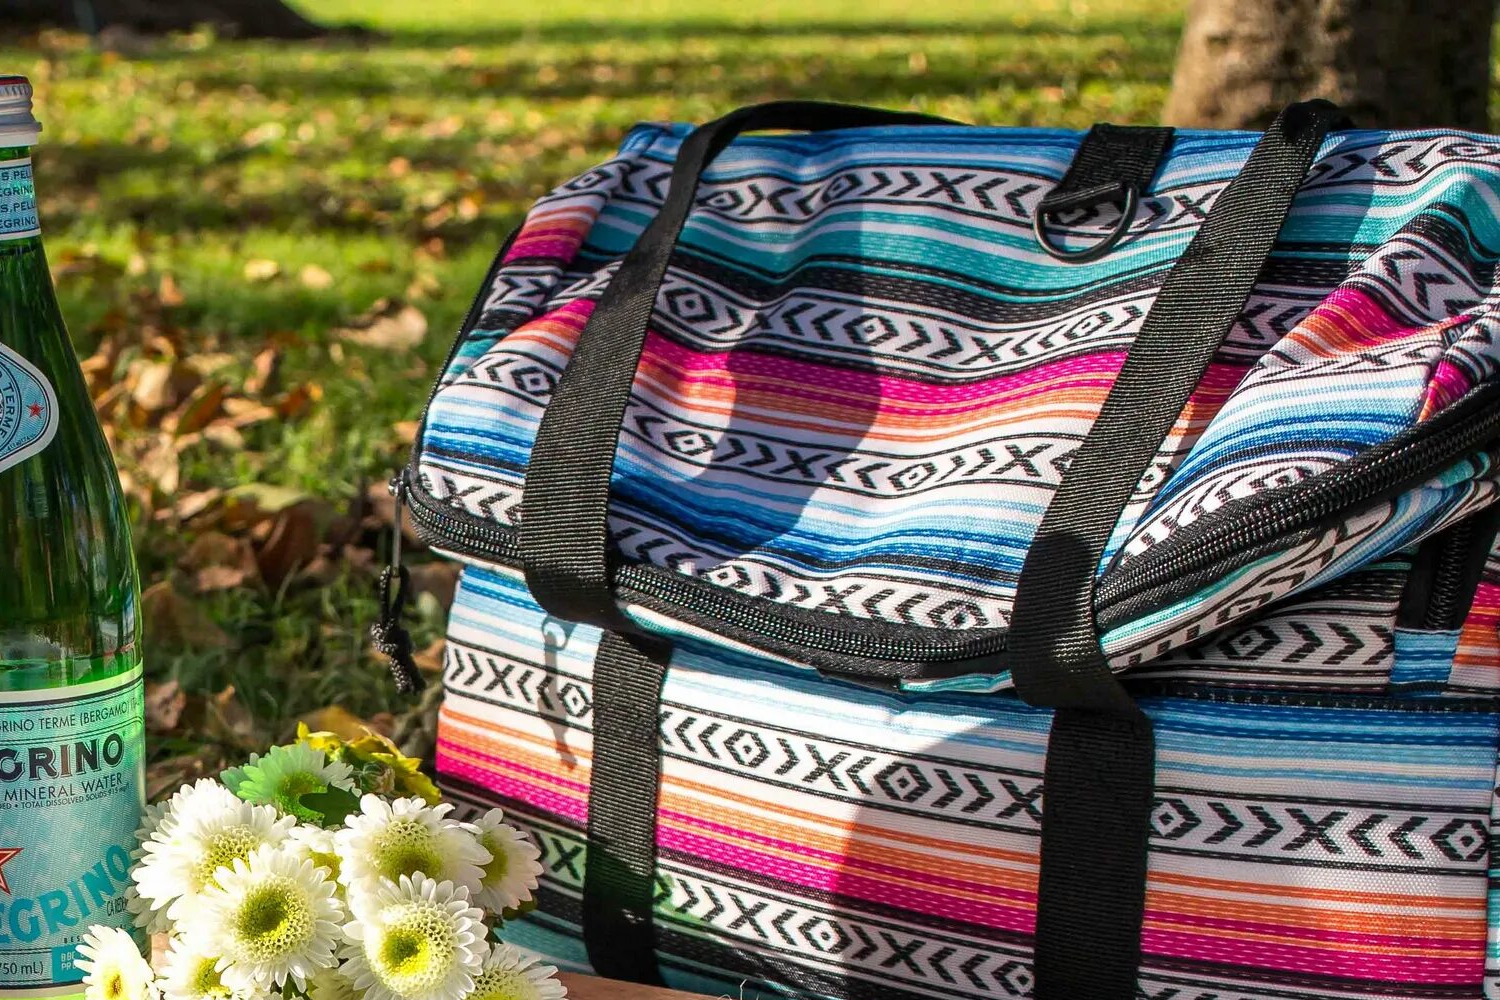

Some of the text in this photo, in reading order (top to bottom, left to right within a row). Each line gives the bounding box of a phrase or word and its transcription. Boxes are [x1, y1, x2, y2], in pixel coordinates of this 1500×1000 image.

[38, 714, 76, 730] TERME
[4, 783, 76, 801] MINERAL
[81, 772, 123, 793] WATER
[22, 801, 45, 810] TOTAL
[46, 795, 84, 807] DISSOLVED
[20, 961, 44, 976] mL)
